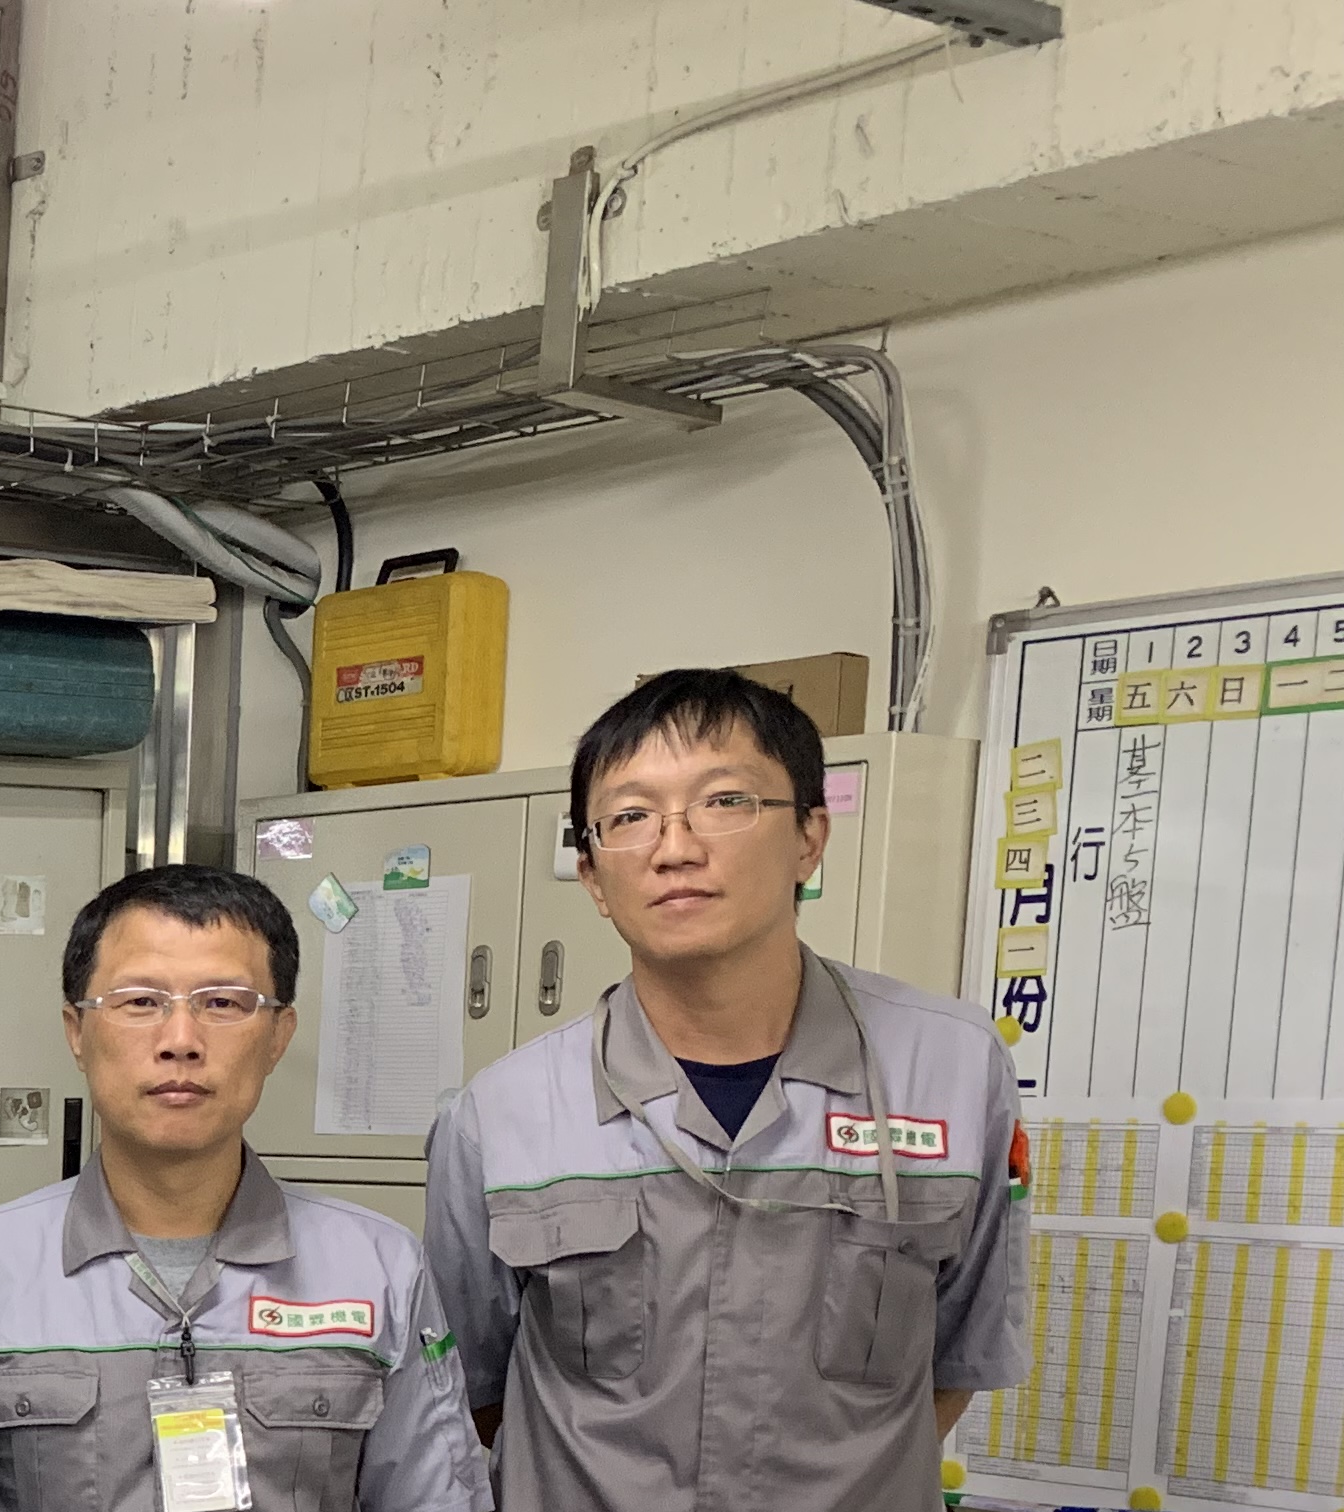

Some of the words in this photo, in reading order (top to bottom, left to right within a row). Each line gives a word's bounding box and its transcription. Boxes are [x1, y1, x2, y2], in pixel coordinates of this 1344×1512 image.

[1186, 636, 1204, 659] 2
[1233, 631, 1252, 655] 3
[1283, 625, 1301, 648] 4
[1090, 640, 1118, 675] 日期
[1146, 641, 1154, 664] 1
[1122, 682, 1152, 711] 五
[1166, 680, 1197, 710] 六
[1219, 676, 1246, 705] 日
[1087, 688, 1115, 723] 星期
[1005, 847, 1032, 873] 四
[1070, 827, 1106, 882] 行
